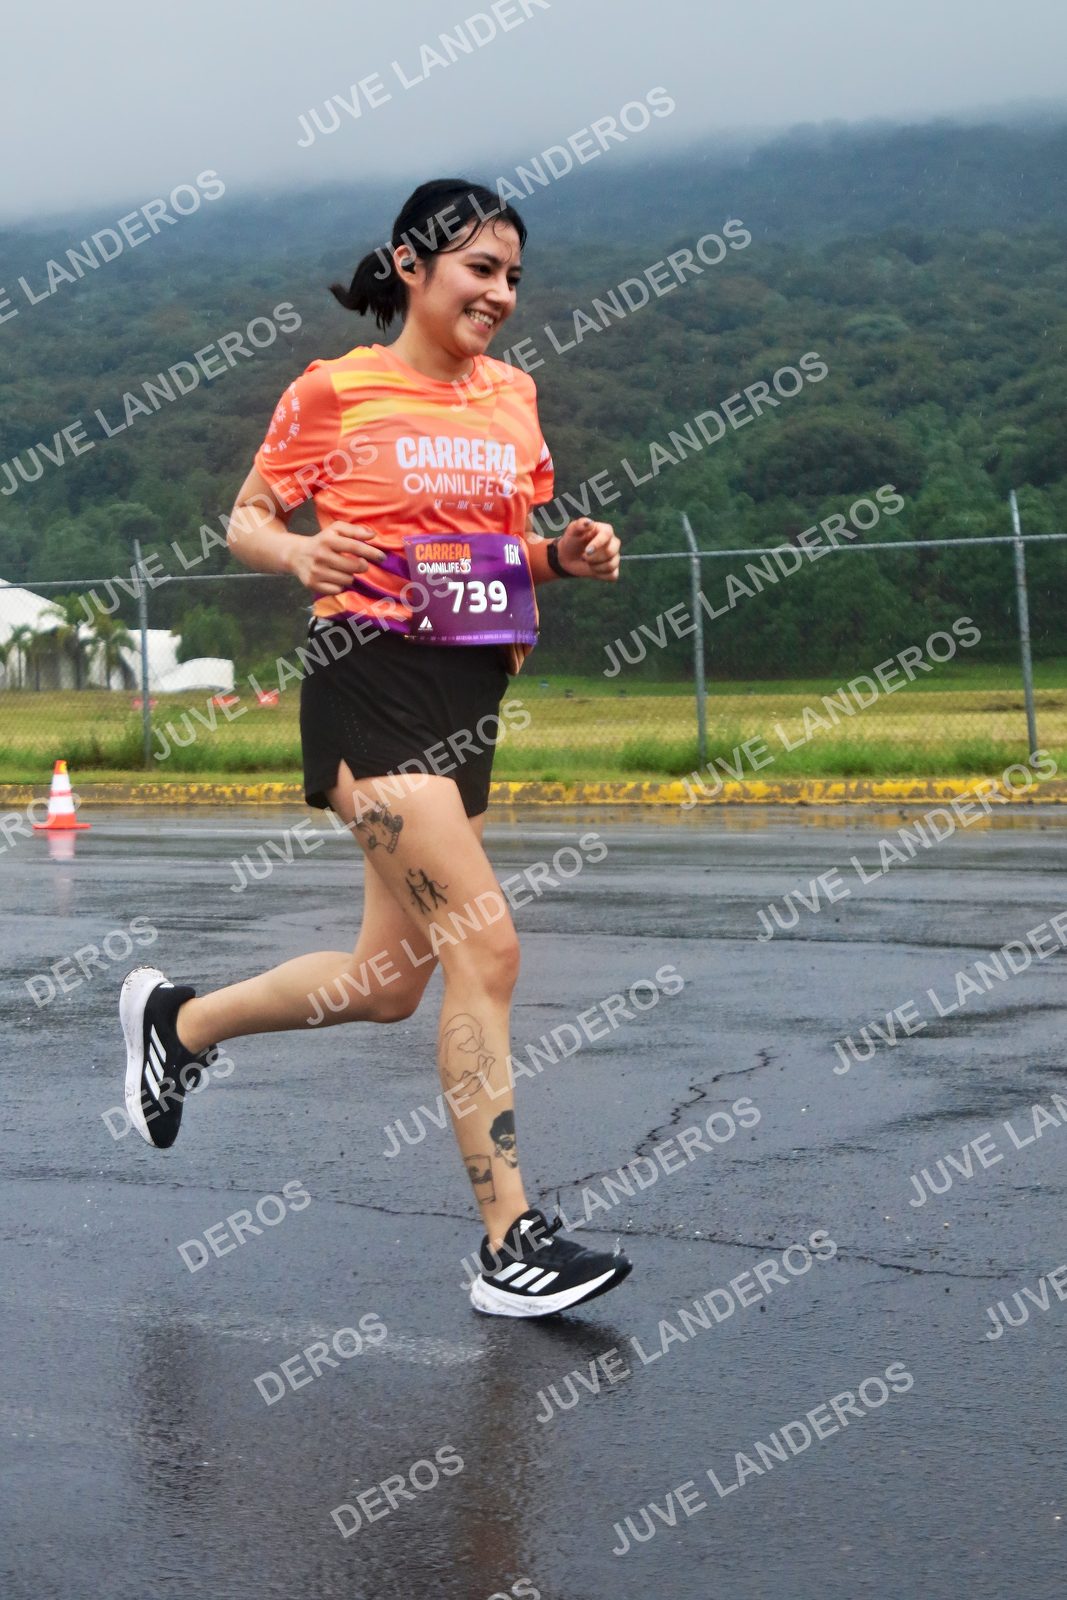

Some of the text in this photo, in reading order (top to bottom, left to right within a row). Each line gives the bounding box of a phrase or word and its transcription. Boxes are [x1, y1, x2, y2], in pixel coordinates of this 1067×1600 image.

[395, 436, 517, 477] CARRERA
[403, 473, 495, 497] OMNILIFE
[415, 543, 471, 561] CARRERA
[417, 561, 460, 574] OMNILIFE
[447, 580, 508, 614] 739
